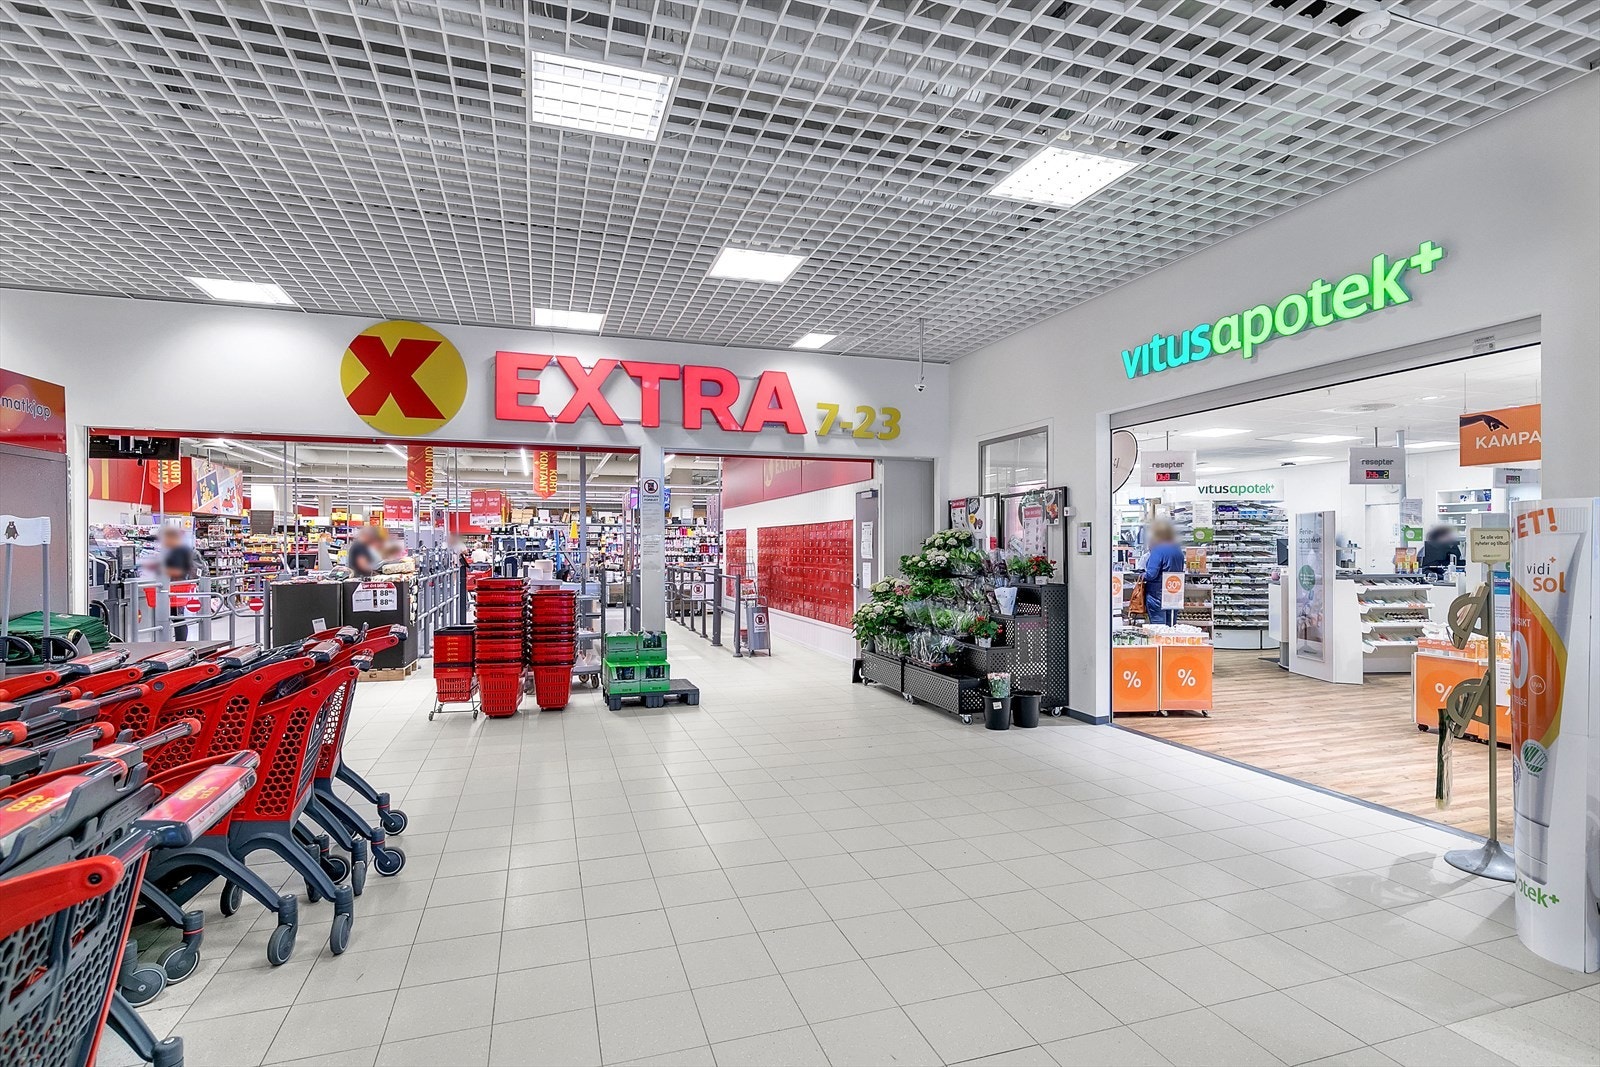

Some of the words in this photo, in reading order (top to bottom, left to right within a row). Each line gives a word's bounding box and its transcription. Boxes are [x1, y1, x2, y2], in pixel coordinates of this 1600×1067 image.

[496, 351, 807, 435] EXTRA
[816, 402, 901, 440] 7-23
[539, 451, 548, 493] KONTANT
[1152, 461, 1184, 469] resepter
[549, 469, 558, 492] KORT
[1526, 562, 1550, 575] vidi
[1533, 571, 1566, 593] sol
